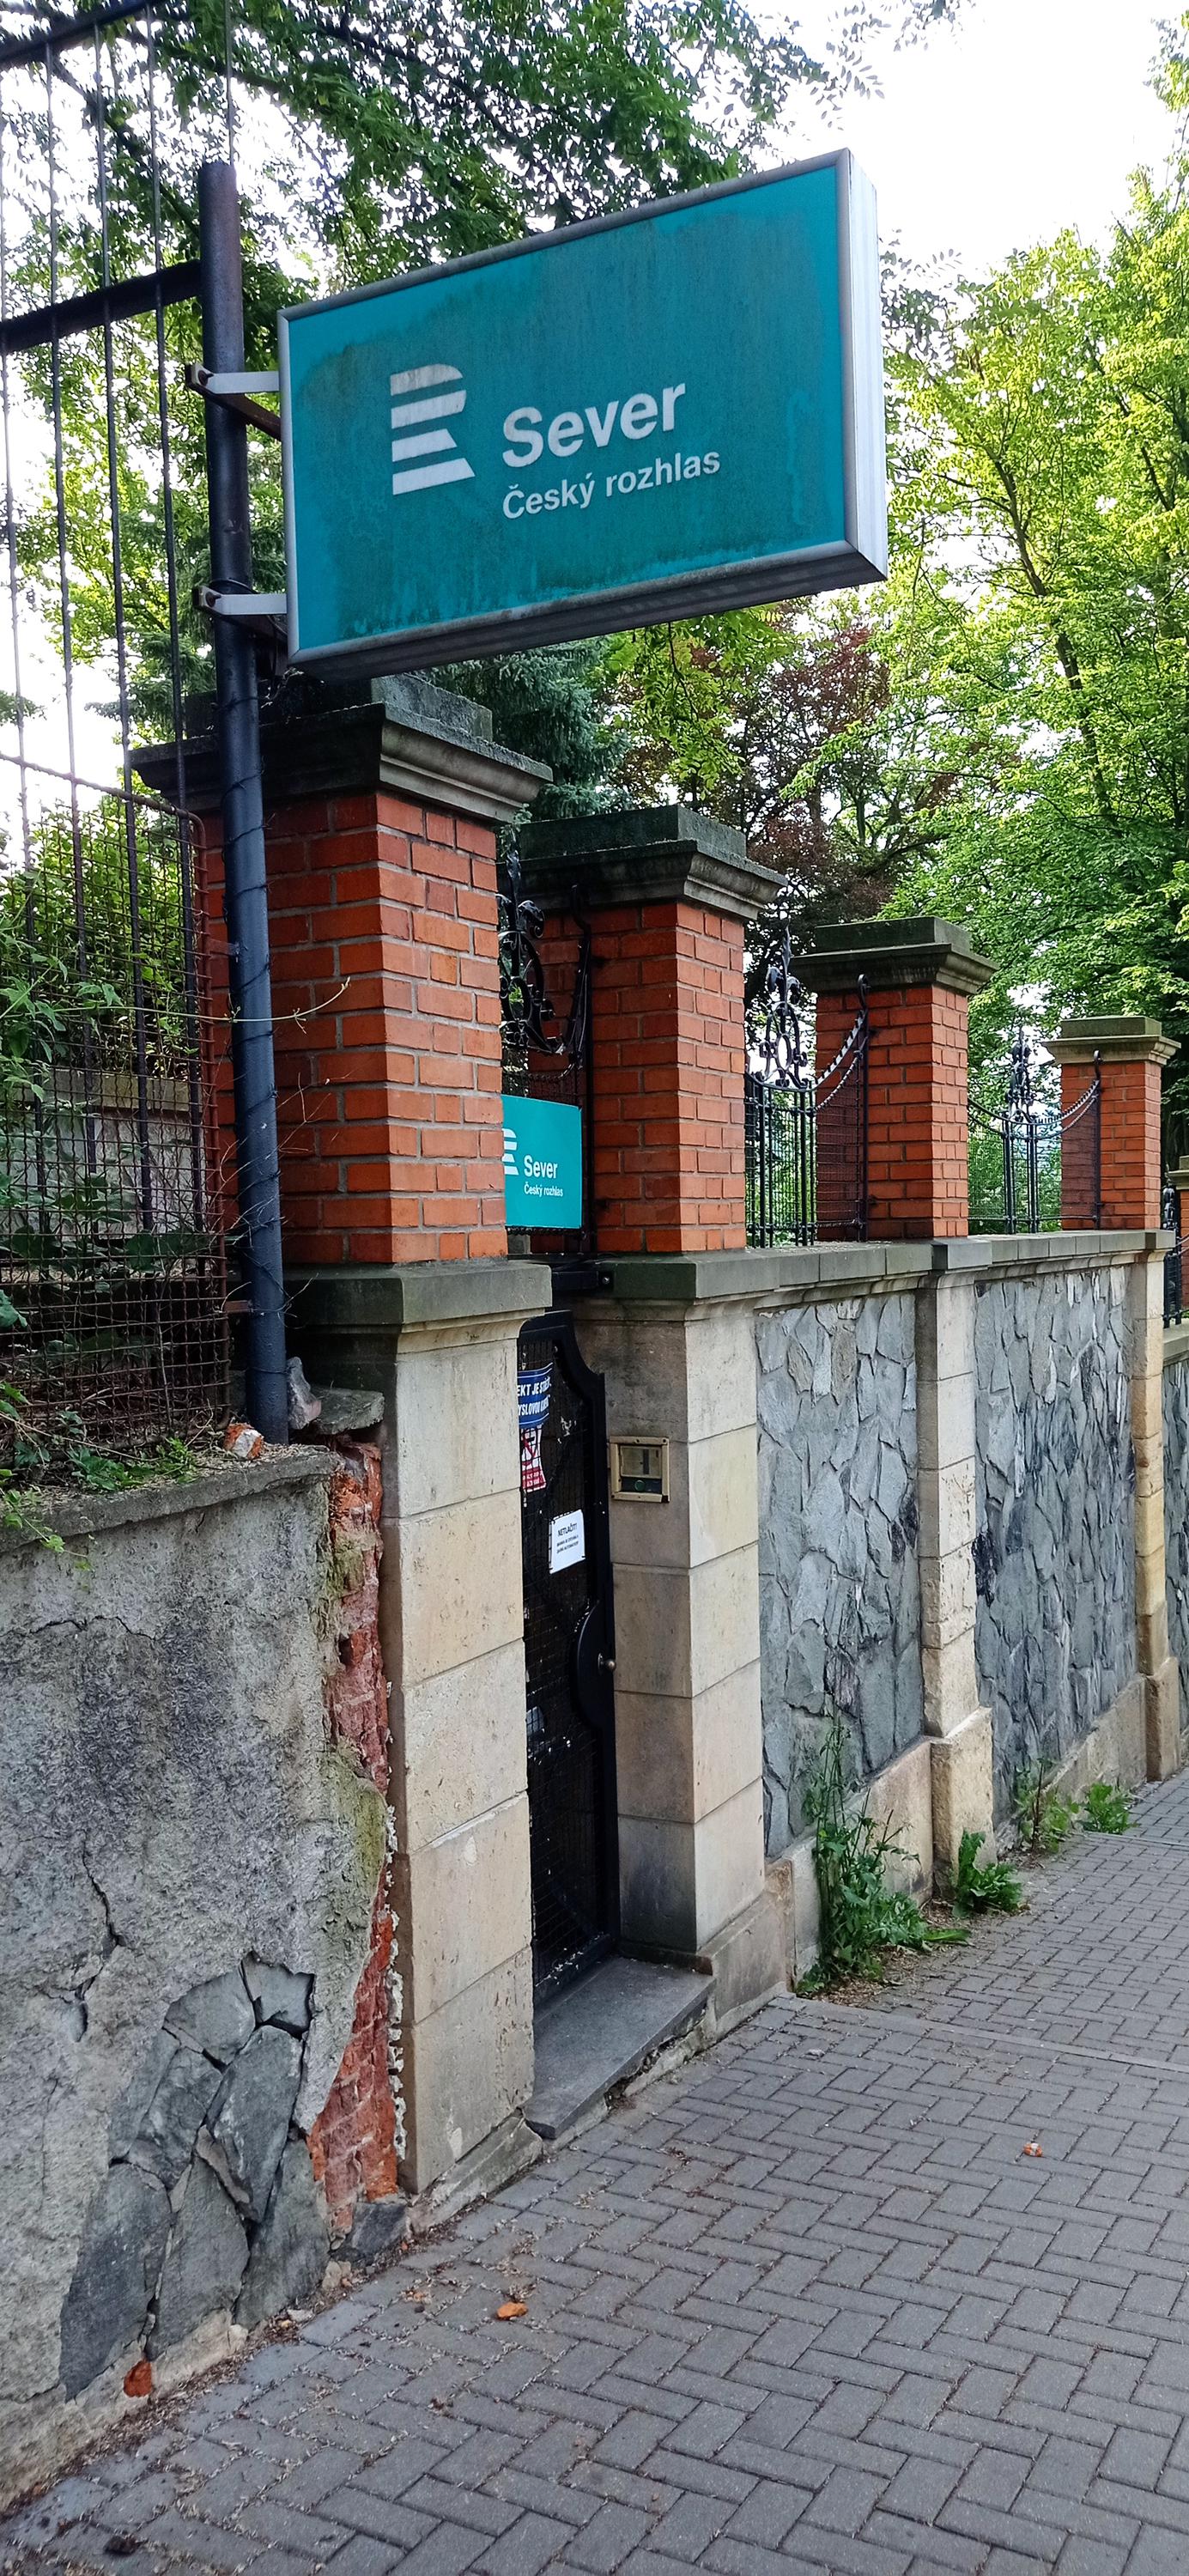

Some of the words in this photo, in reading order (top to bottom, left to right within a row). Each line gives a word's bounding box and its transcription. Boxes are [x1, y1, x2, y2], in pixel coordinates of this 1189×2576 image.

[501, 382, 686, 468] Sever
[502, 473, 596, 519] Český
[606, 451, 721, 497] rozhlas
[524, 1154, 558, 1179] Sever
[524, 1182, 543, 1197] Český
[543, 1186, 563, 1197] rozhlas
